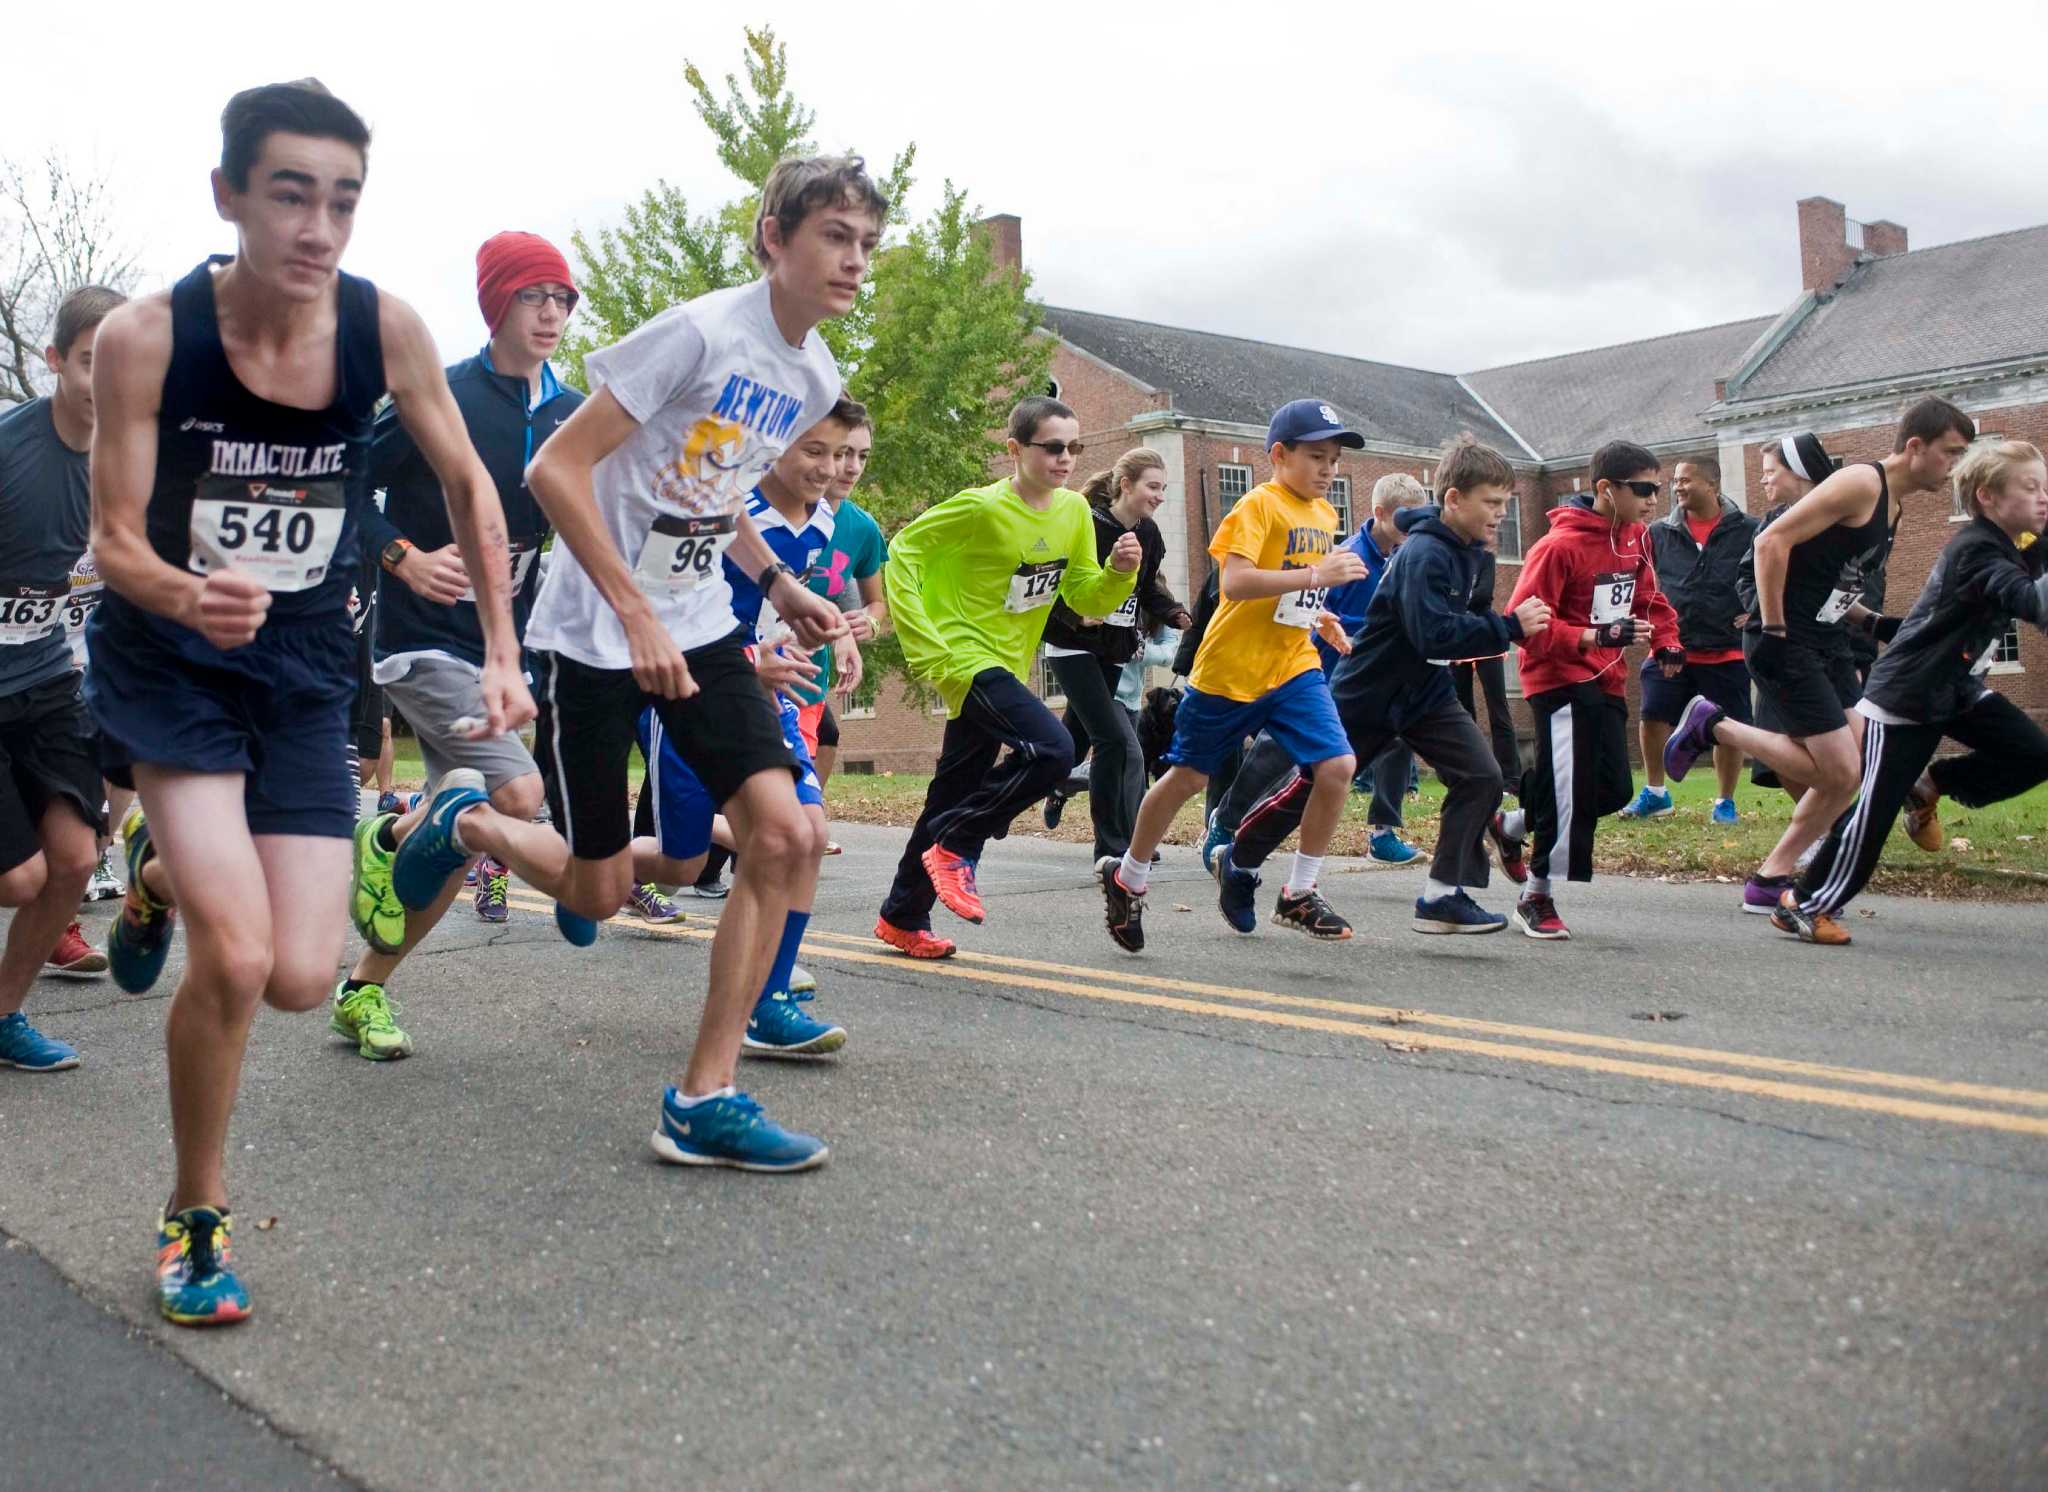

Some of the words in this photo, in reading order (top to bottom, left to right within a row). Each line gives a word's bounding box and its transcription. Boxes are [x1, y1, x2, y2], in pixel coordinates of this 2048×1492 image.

[210, 439, 347, 478] IMMACULATE
[218, 505, 315, 554] 540
[671, 537, 716, 574] 96
[1024, 571, 1062, 598] 174
[1611, 583, 1634, 606] 87
[0, 598, 56, 624] 163
[1115, 599, 1136, 614] 15
[1295, 587, 1326, 610] 159
[69, 603, 97, 627] 9
